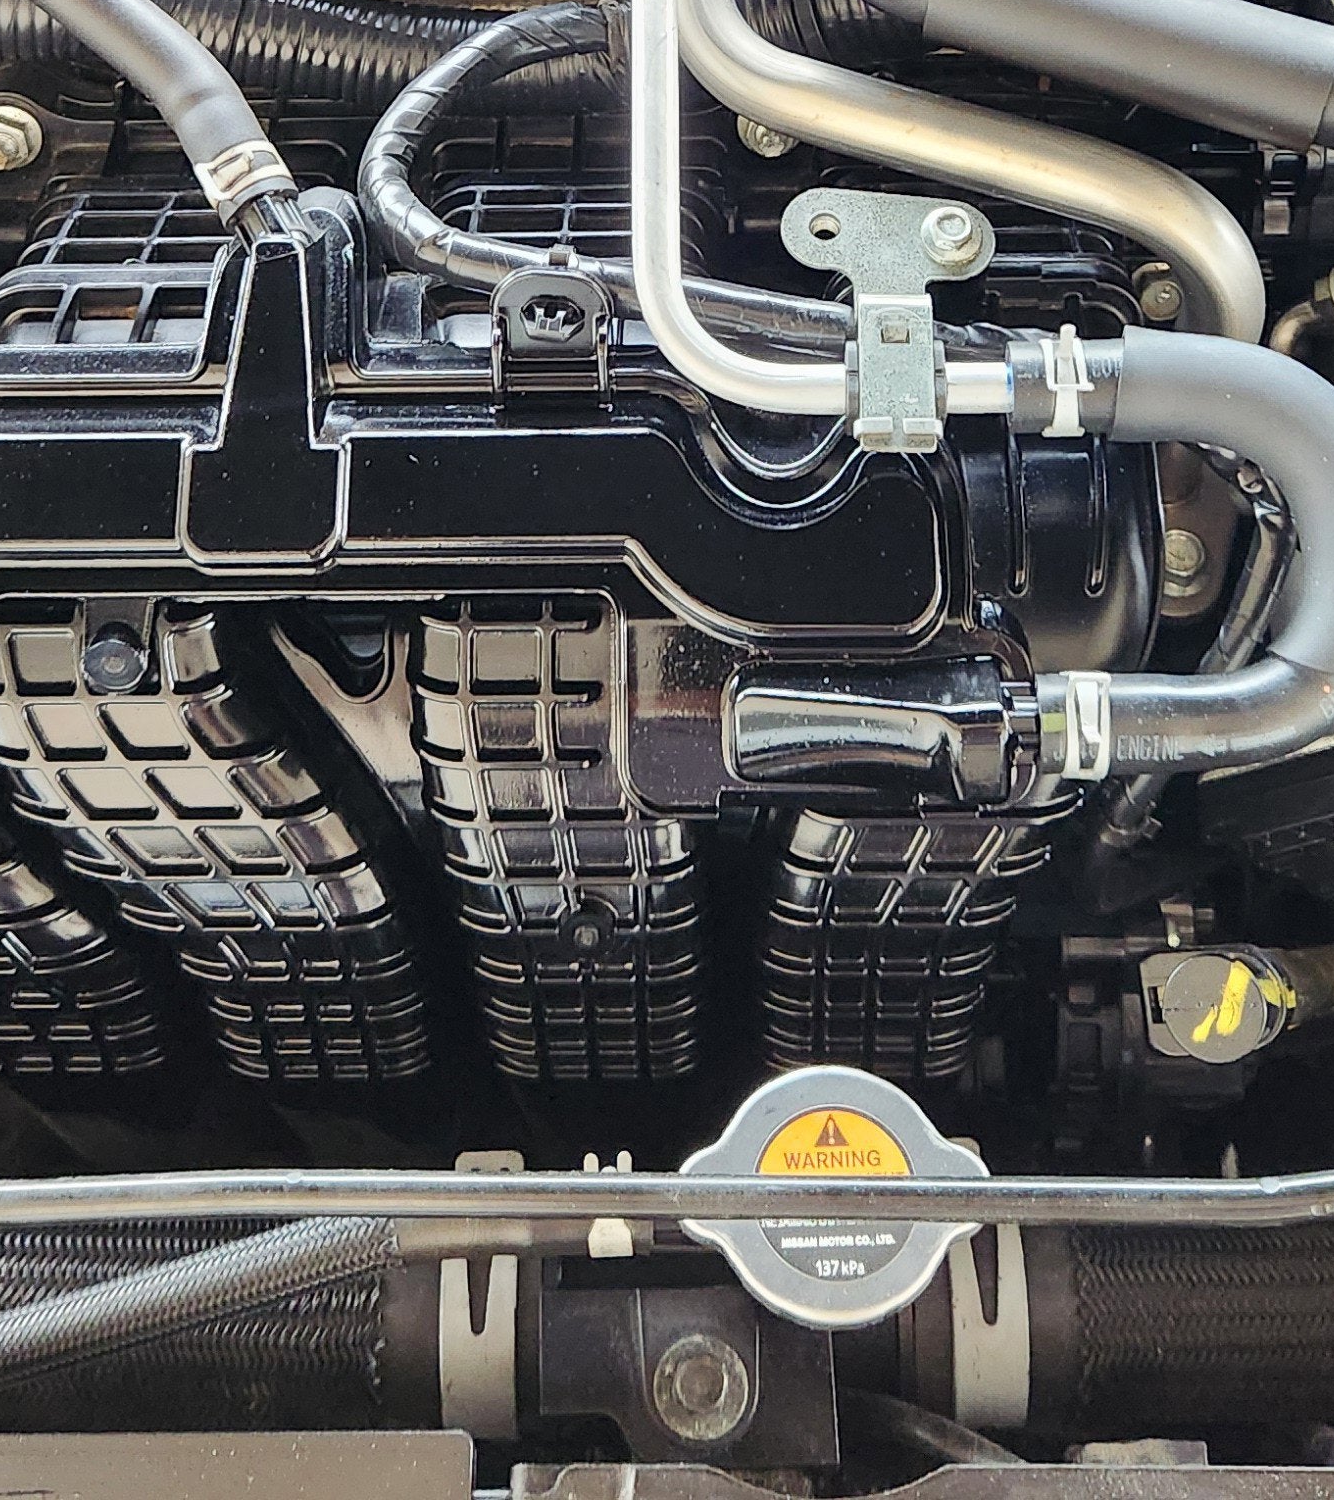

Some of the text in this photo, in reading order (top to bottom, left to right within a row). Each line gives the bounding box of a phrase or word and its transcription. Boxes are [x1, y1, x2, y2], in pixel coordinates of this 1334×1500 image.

[1115, 734, 1186, 762] ENGINE
[783, 1149, 881, 1170] WARNING
[781, 1233, 896, 1249] NISSAN MOTOR CO., LTD.
[815, 1259, 865, 1277] 137 kPa
